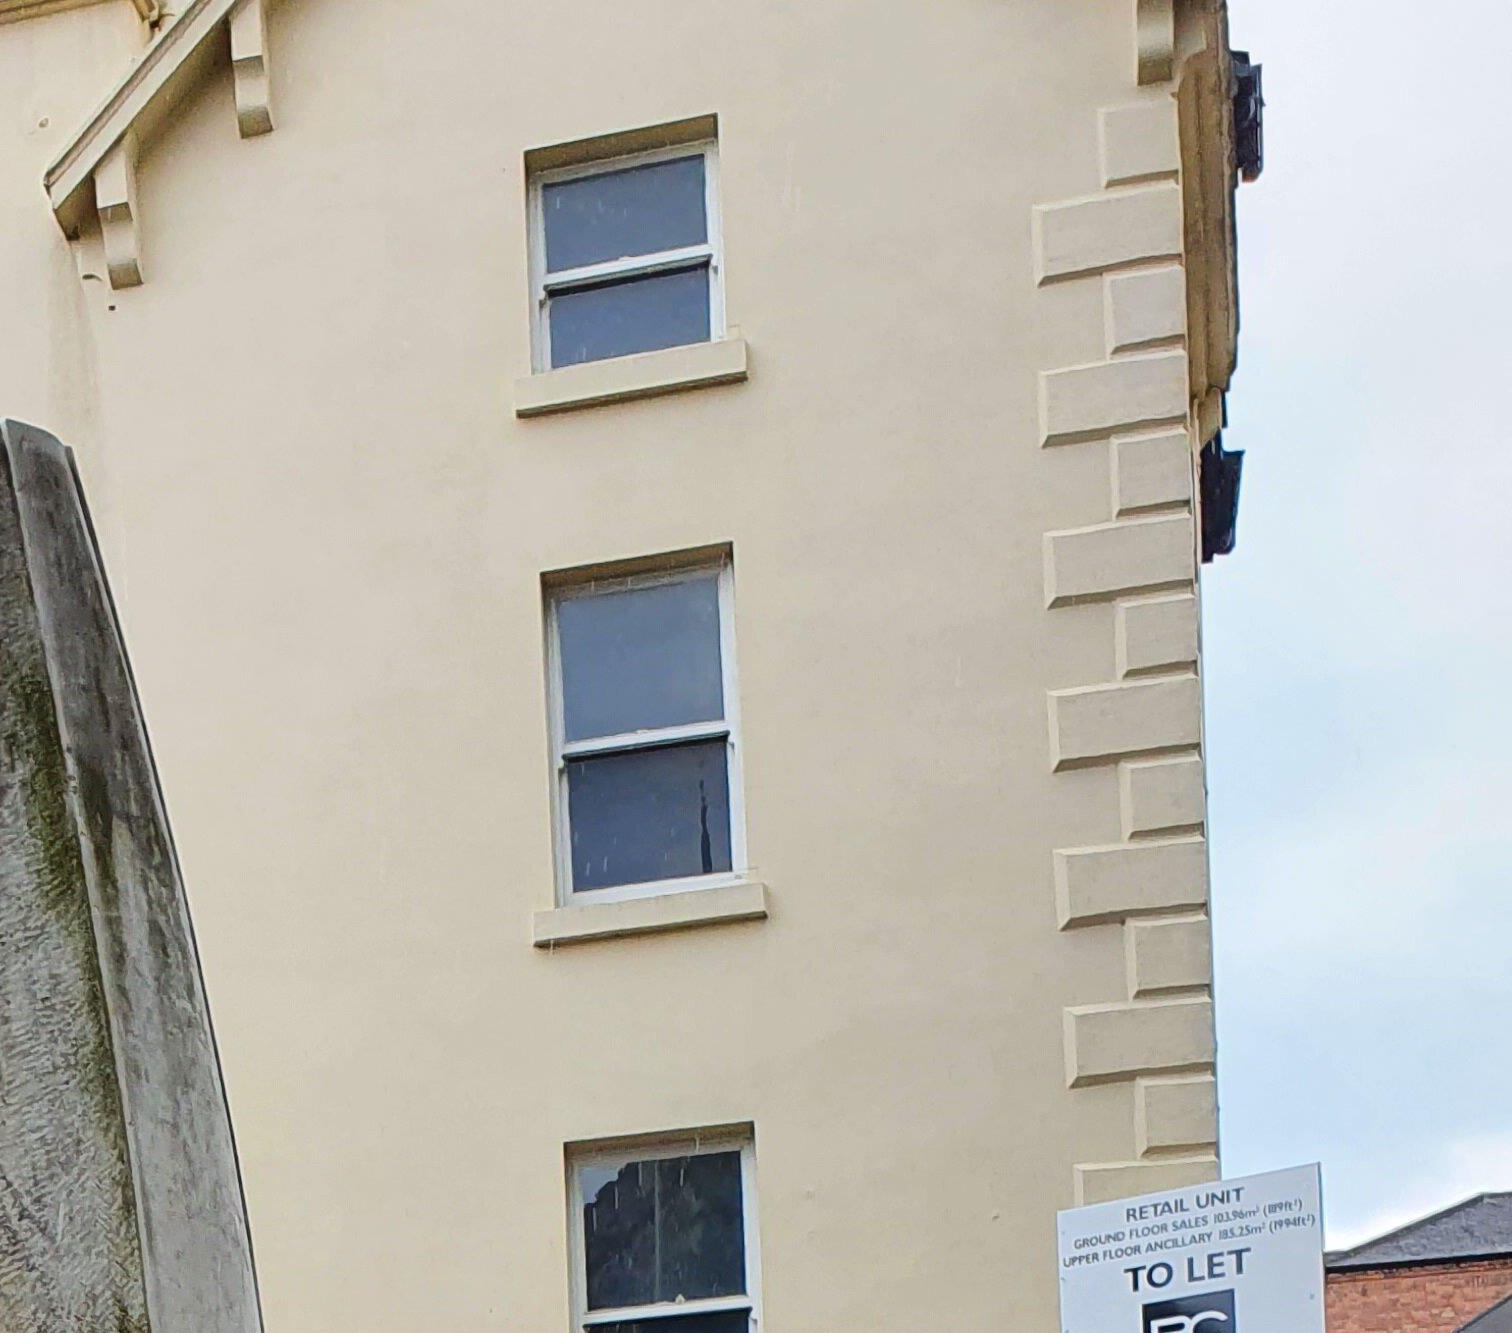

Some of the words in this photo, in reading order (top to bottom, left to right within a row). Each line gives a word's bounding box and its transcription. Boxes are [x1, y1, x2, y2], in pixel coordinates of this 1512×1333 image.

[1126, 1198, 1190, 1222] RETAIL
[1196, 1187, 1245, 1209] UNIT
[1063, 1251, 1100, 1268] UPPER
[1102, 1245, 1141, 1260] FLOOR
[1145, 1231, 1212, 1251] ANCILLARY
[1074, 1231, 1125, 1250] GROUND
[1129, 1223, 1168, 1240] FLOOR
[1172, 1215, 1208, 1232] SALES
[1123, 1262, 1173, 1292] TO
[1187, 1248, 1251, 1283] LET
